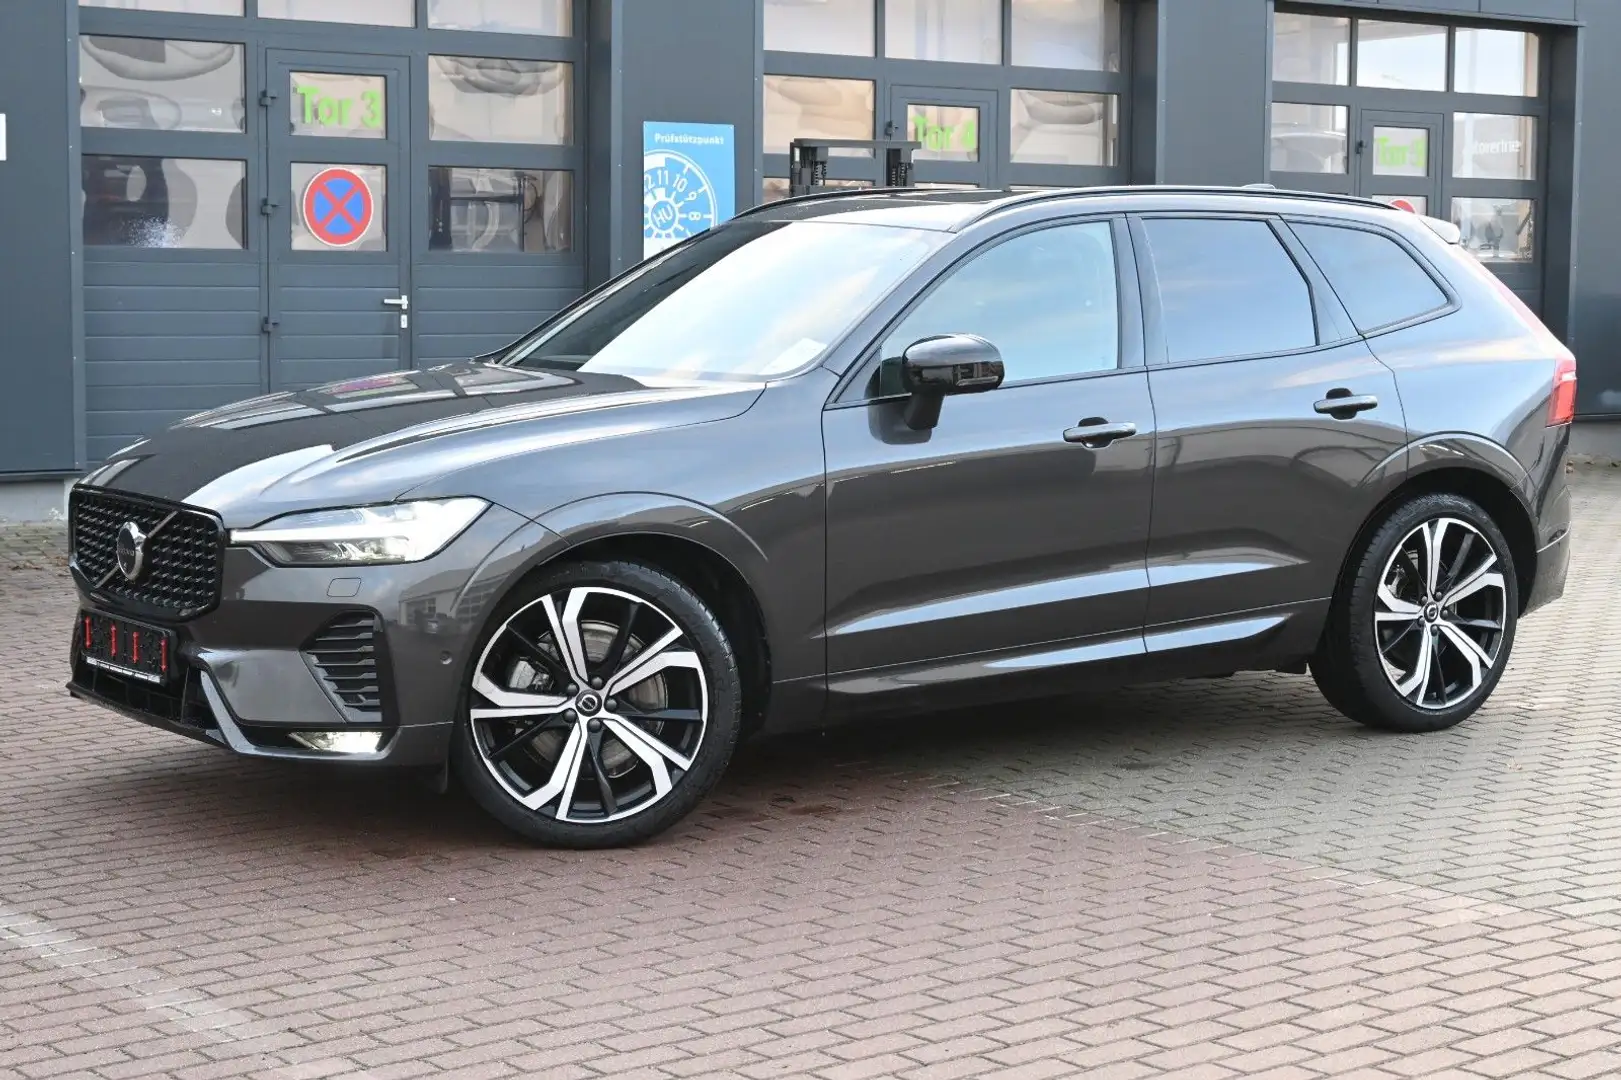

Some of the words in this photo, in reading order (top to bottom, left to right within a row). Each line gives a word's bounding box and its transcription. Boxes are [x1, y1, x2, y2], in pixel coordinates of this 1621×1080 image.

[297, 86, 354, 127] Tor
[360, 89, 381, 128] 3
[654, 132, 724, 145] Prüfstützpunkt
[912, 115, 955, 151] Tor
[961, 119, 976, 149] 4
[657, 169, 669, 185] 11
[673, 173, 688, 192] 10
[653, 204, 674, 228] HU
[688, 211, 701, 221] 8
